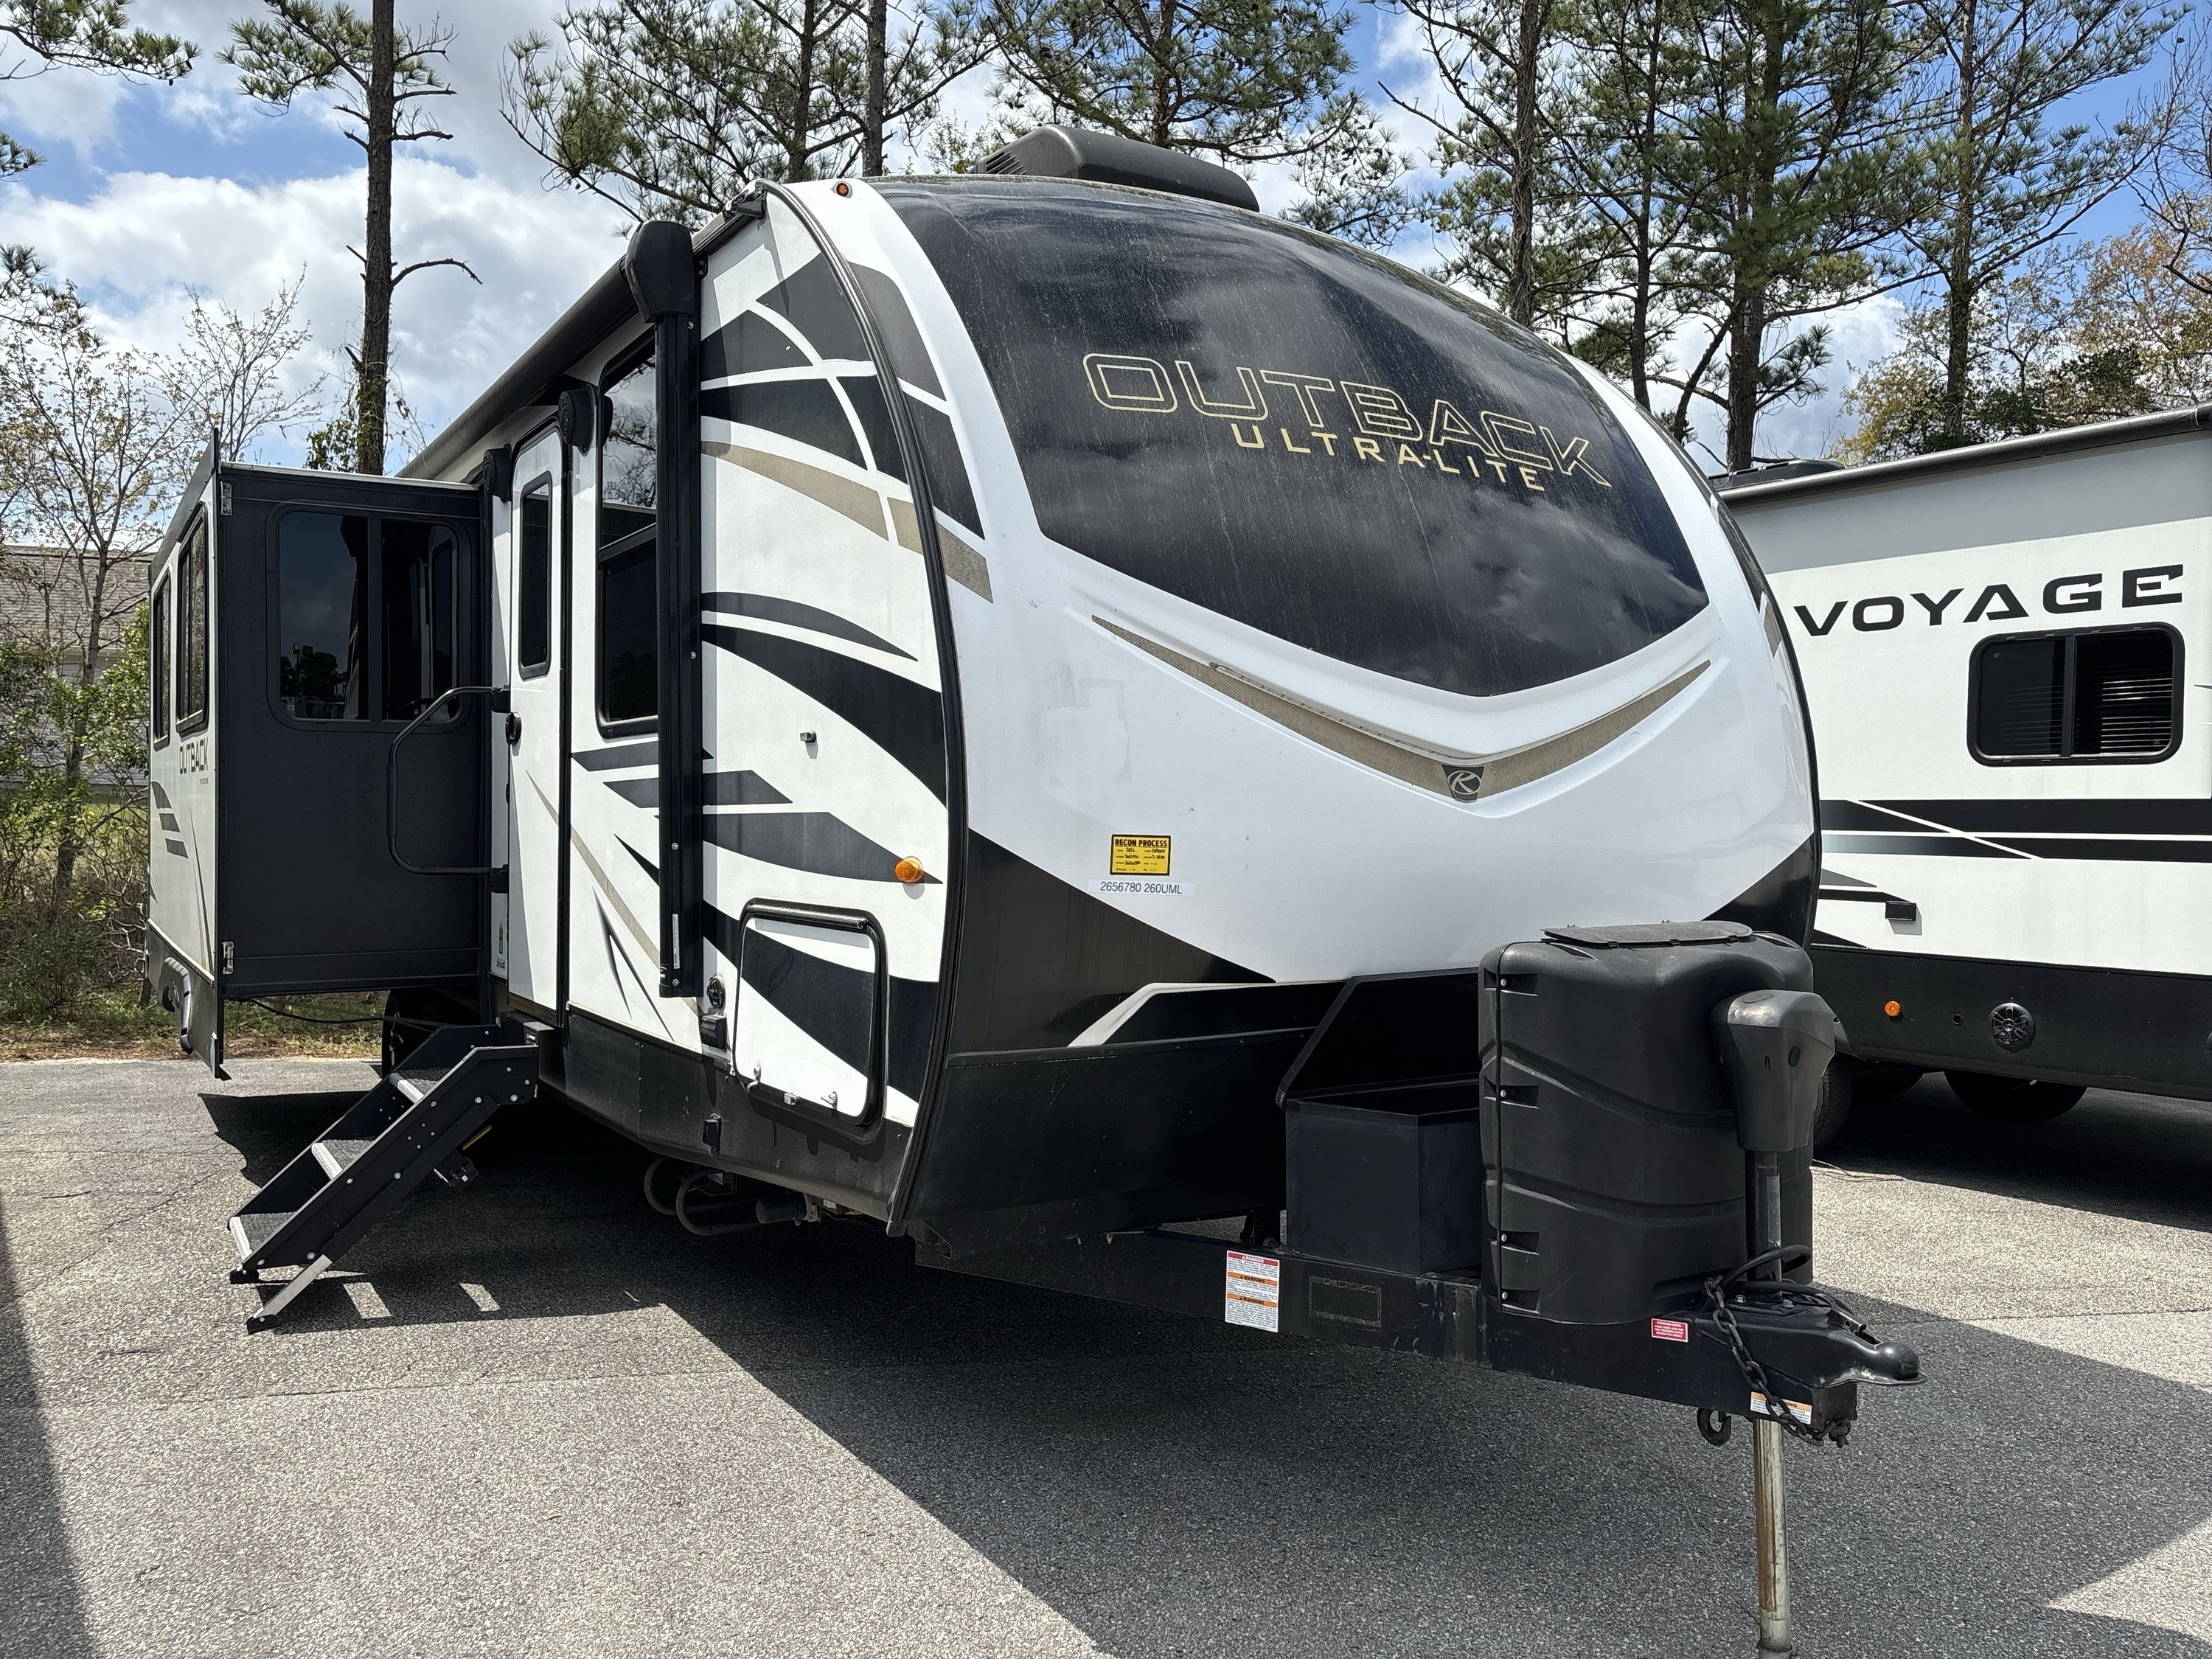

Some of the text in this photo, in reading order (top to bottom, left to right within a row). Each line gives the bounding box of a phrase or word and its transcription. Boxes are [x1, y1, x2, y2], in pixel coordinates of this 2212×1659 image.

[1082, 352, 1612, 487] OUTBACK
[1231, 422, 1545, 492] ULTRA-LITE
[1793, 564, 2184, 636] VOYAGE
[179, 737, 209, 774] OUTBACK
[1115, 838, 1167, 847] RECON PROCESS
[1100, 881, 1183, 894] 2656780 260UML
[1244, 1275, 1265, 1284] WARNING
[1243, 1296, 1265, 1305] WARNING
